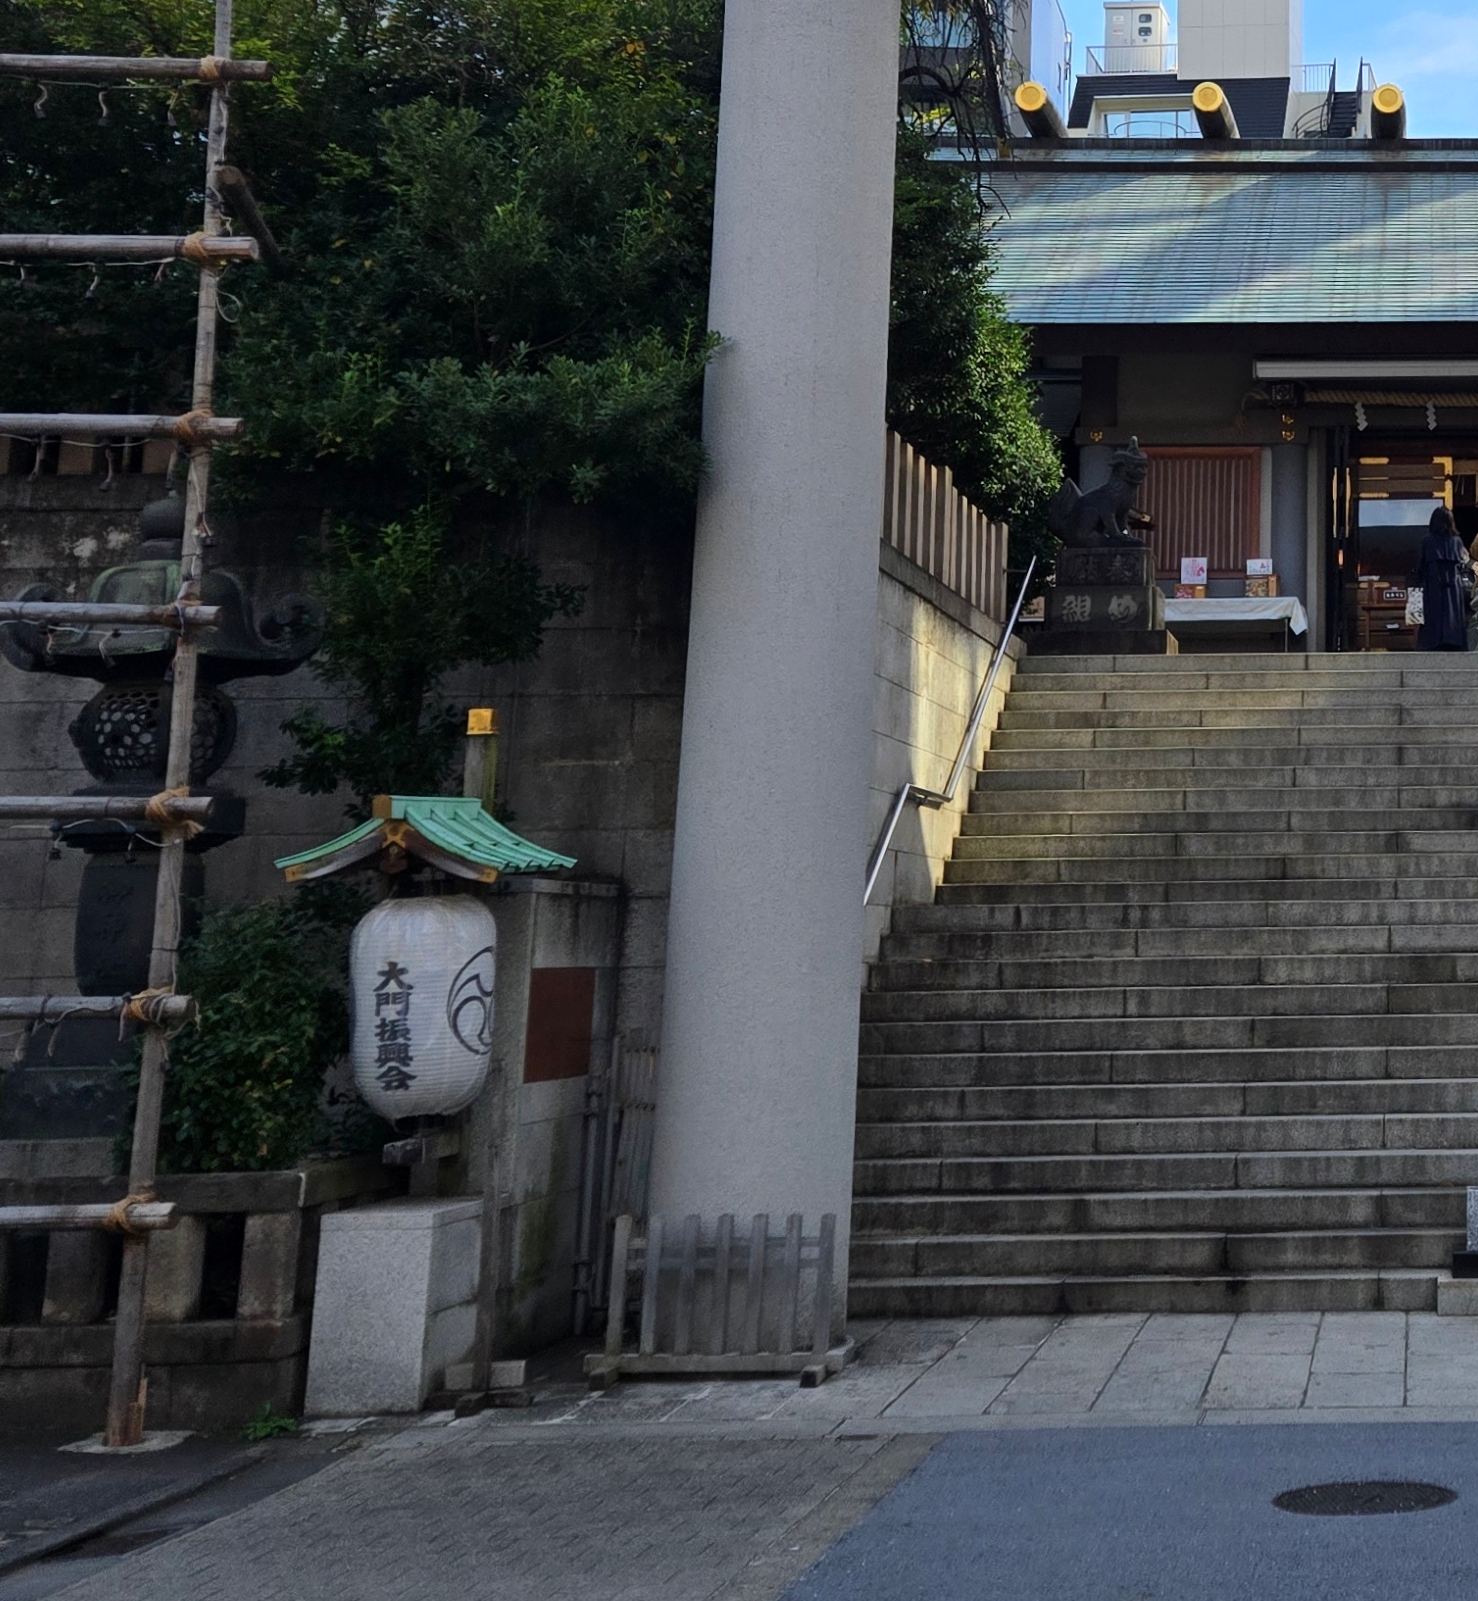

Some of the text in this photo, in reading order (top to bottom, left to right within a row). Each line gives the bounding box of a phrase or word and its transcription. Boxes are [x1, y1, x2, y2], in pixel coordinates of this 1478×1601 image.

[372, 961, 418, 1092] 大門振興会
